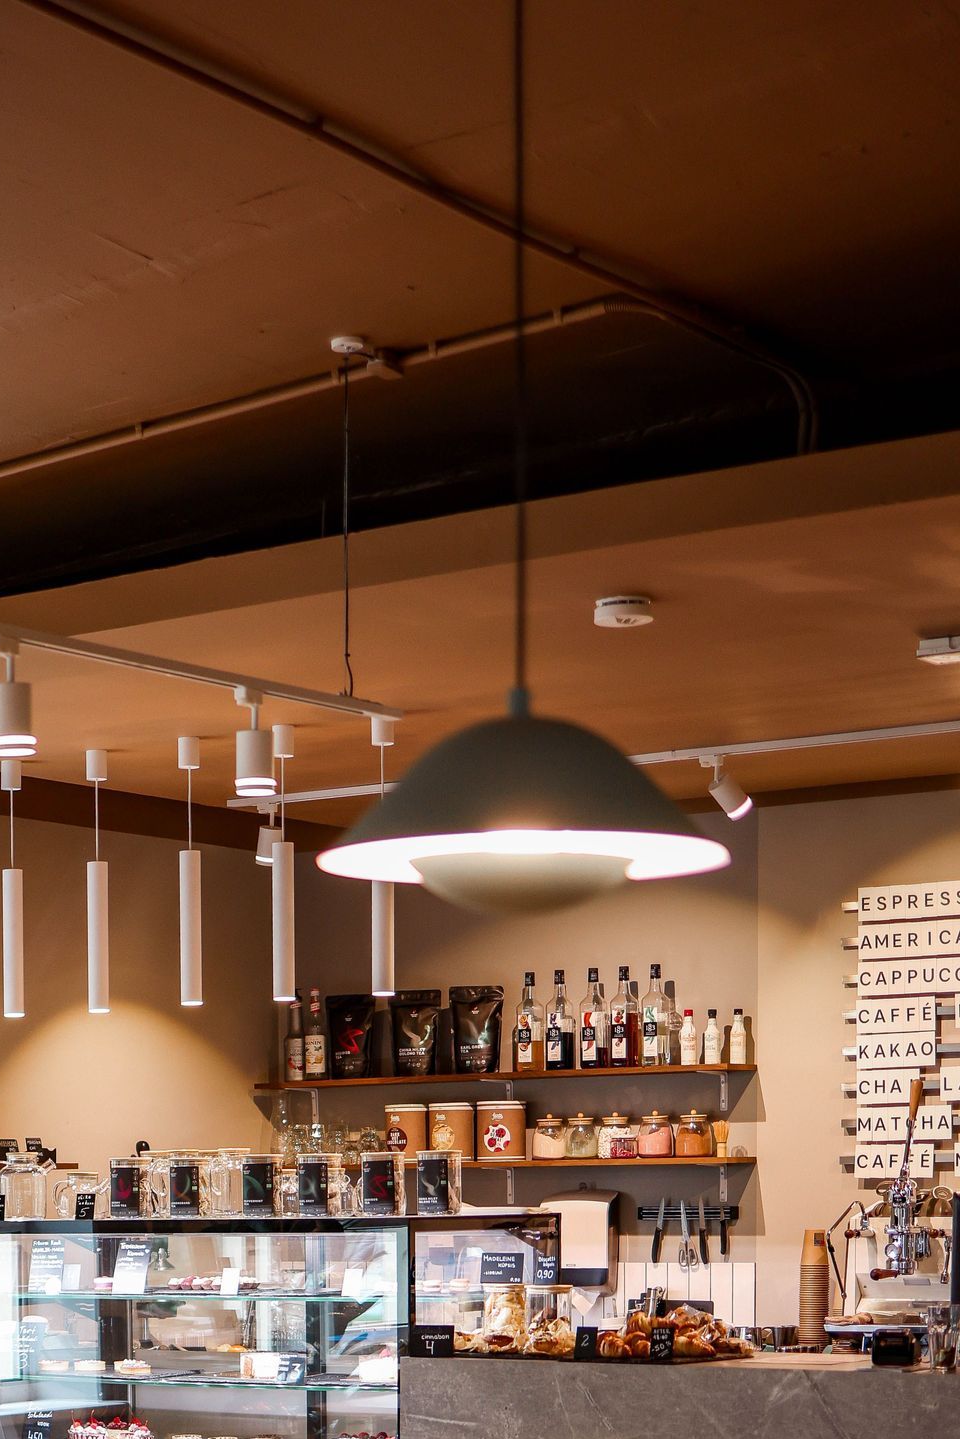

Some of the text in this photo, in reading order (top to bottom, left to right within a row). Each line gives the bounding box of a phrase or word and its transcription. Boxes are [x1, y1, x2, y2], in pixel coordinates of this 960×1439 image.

[858, 1002, 932, 1024] CAFFÉ
[859, 1041, 933, 1059] KAKAO
[78, 1206, 90, 1218] 5
[537, 1269, 554, 1279] 0,90
[425, 1340, 435, 1355] 4
[581, 1334, 589, 1347] 2
